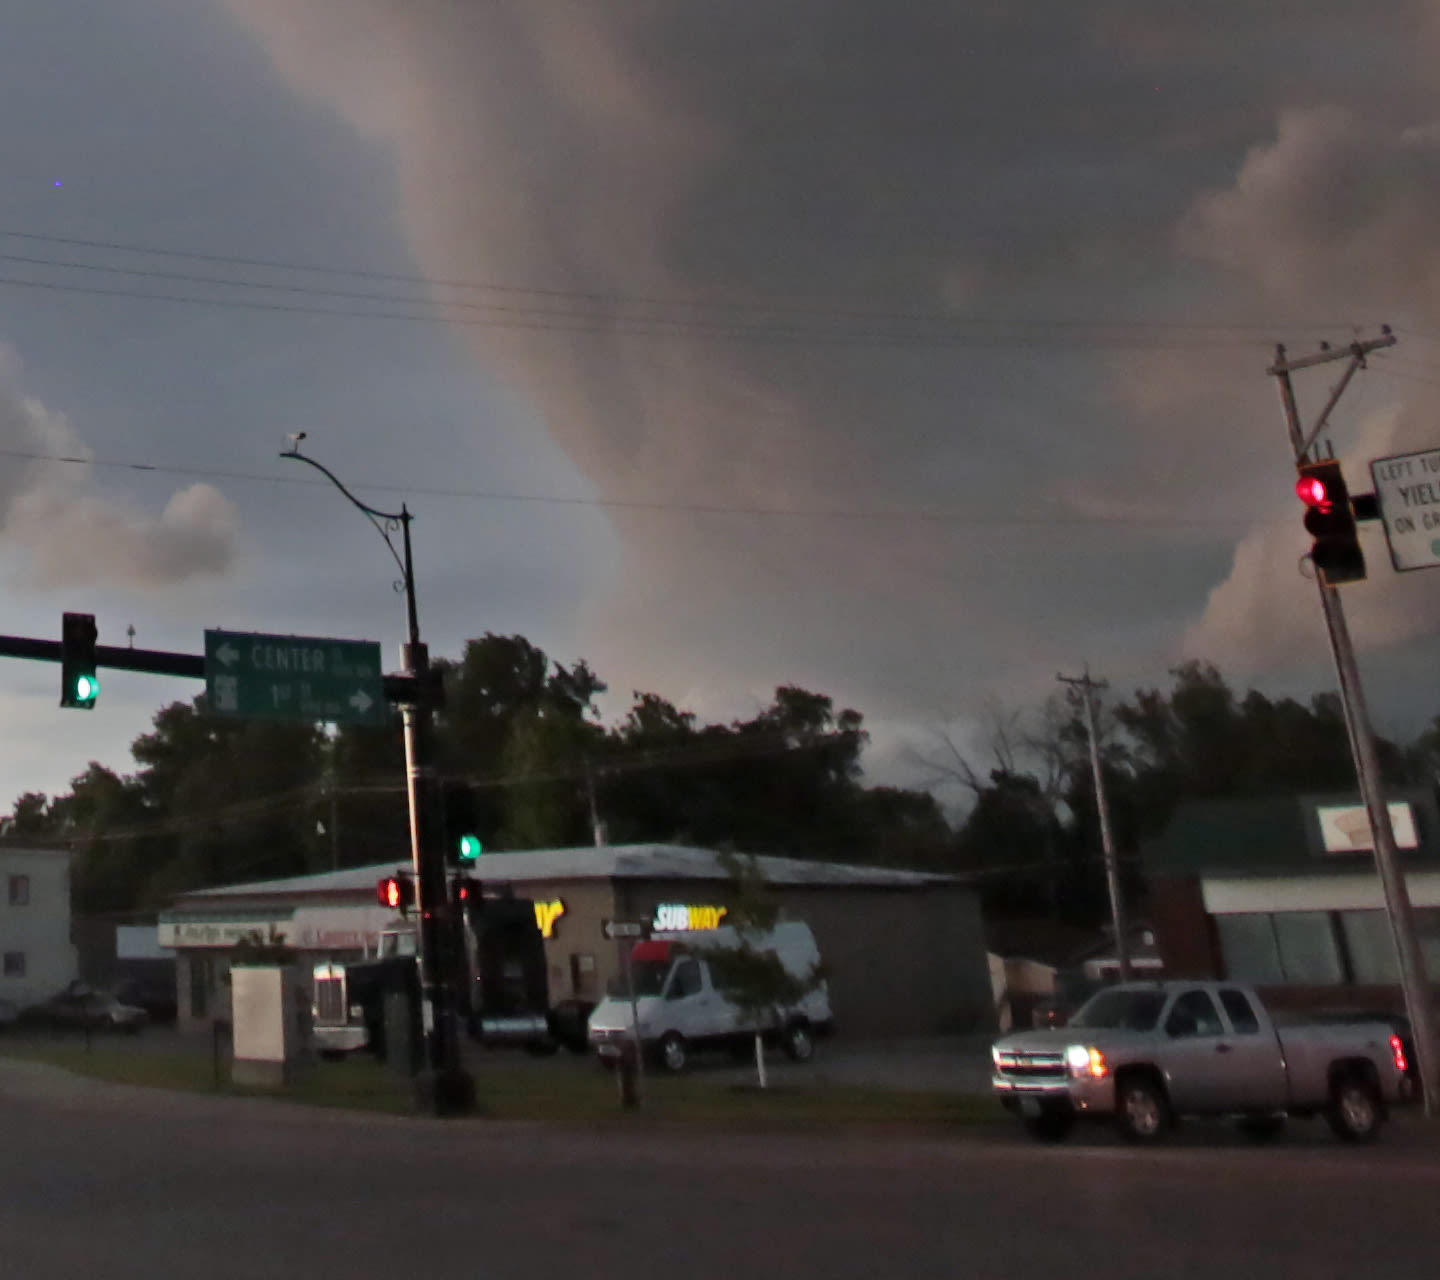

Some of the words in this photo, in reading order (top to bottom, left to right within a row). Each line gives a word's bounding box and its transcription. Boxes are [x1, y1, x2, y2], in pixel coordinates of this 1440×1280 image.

[1380, 460, 1413, 481] LEFT
[1394, 516, 1416, 535] ON
[251, 644, 326, 673] CENTER
[653, 902, 729, 931] SUBWAY
